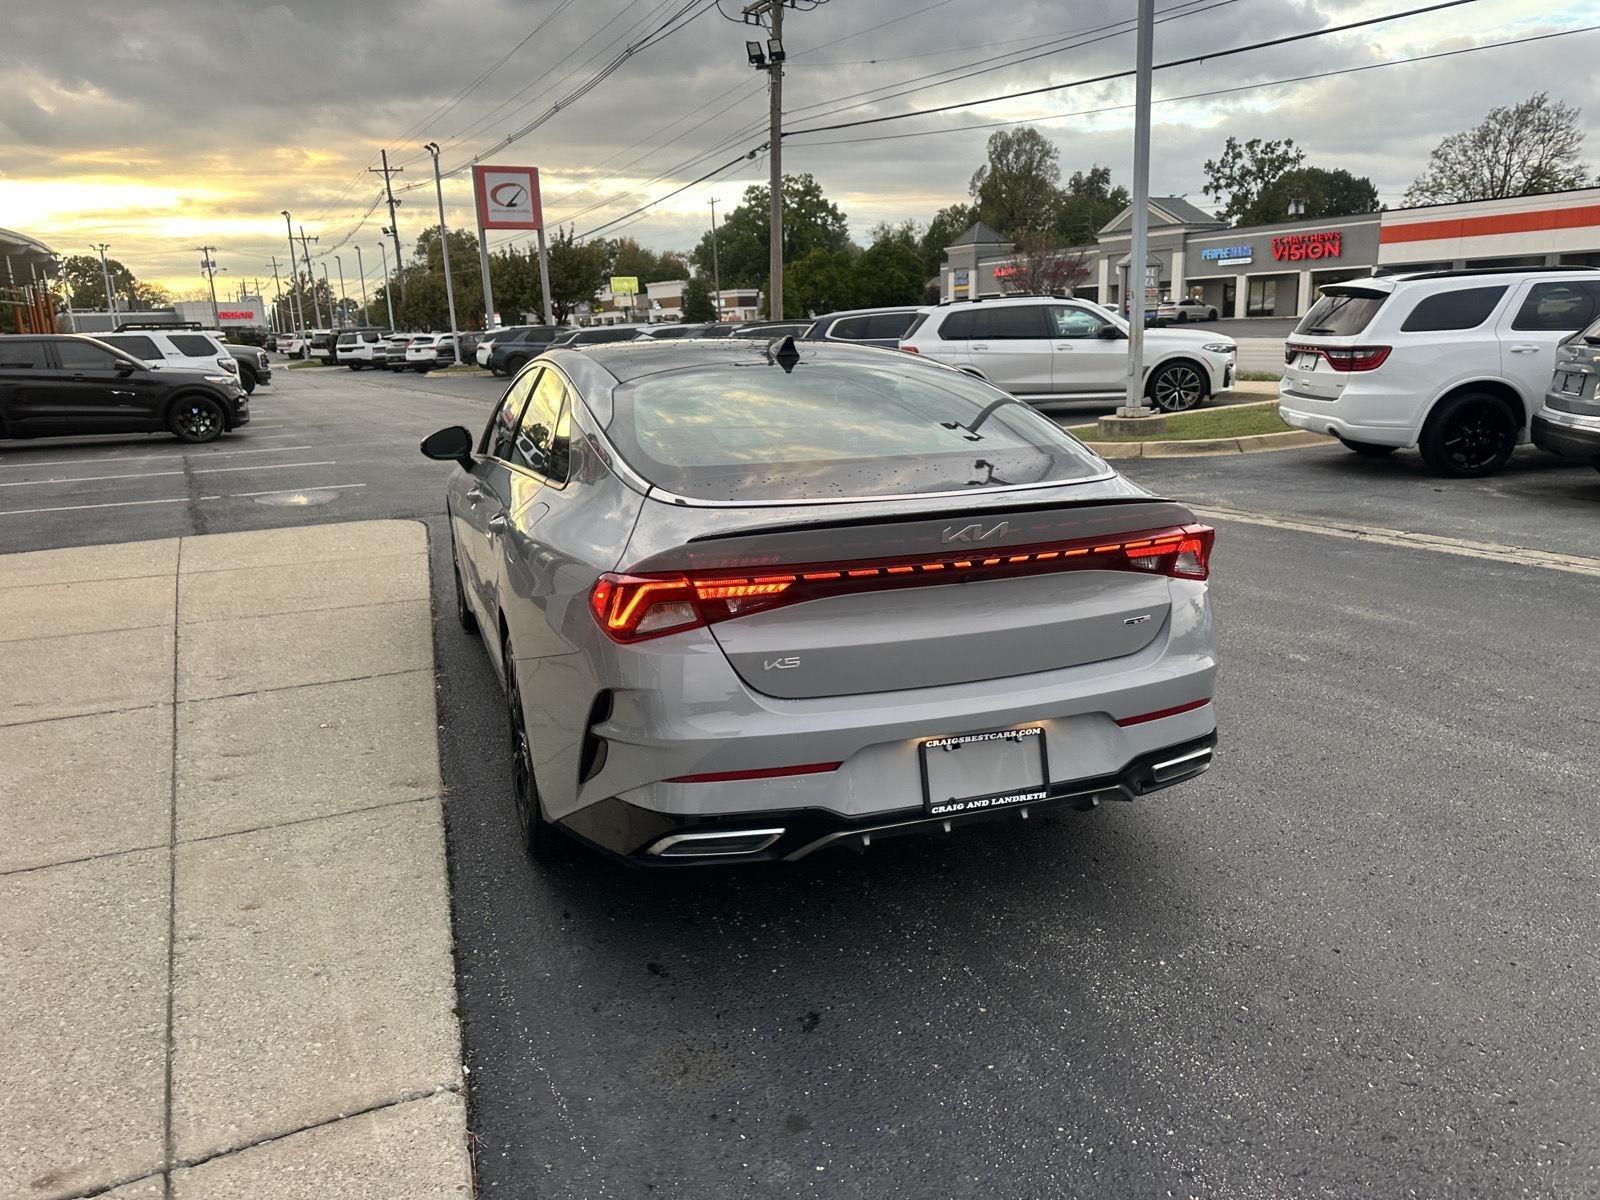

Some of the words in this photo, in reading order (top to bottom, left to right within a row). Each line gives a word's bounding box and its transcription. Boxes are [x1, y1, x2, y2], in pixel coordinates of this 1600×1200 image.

[1284, 231, 1341, 245] MATTHEWS
[1272, 241, 1341, 261] VISION
[764, 656, 801, 671] K5
[925, 727, 1041, 748] CRAIGSBESTCARS.COM
[931, 802, 965, 814] CRAIG
[966, 798, 989, 809] AND
[991, 791, 1047, 805] LANDRETH
